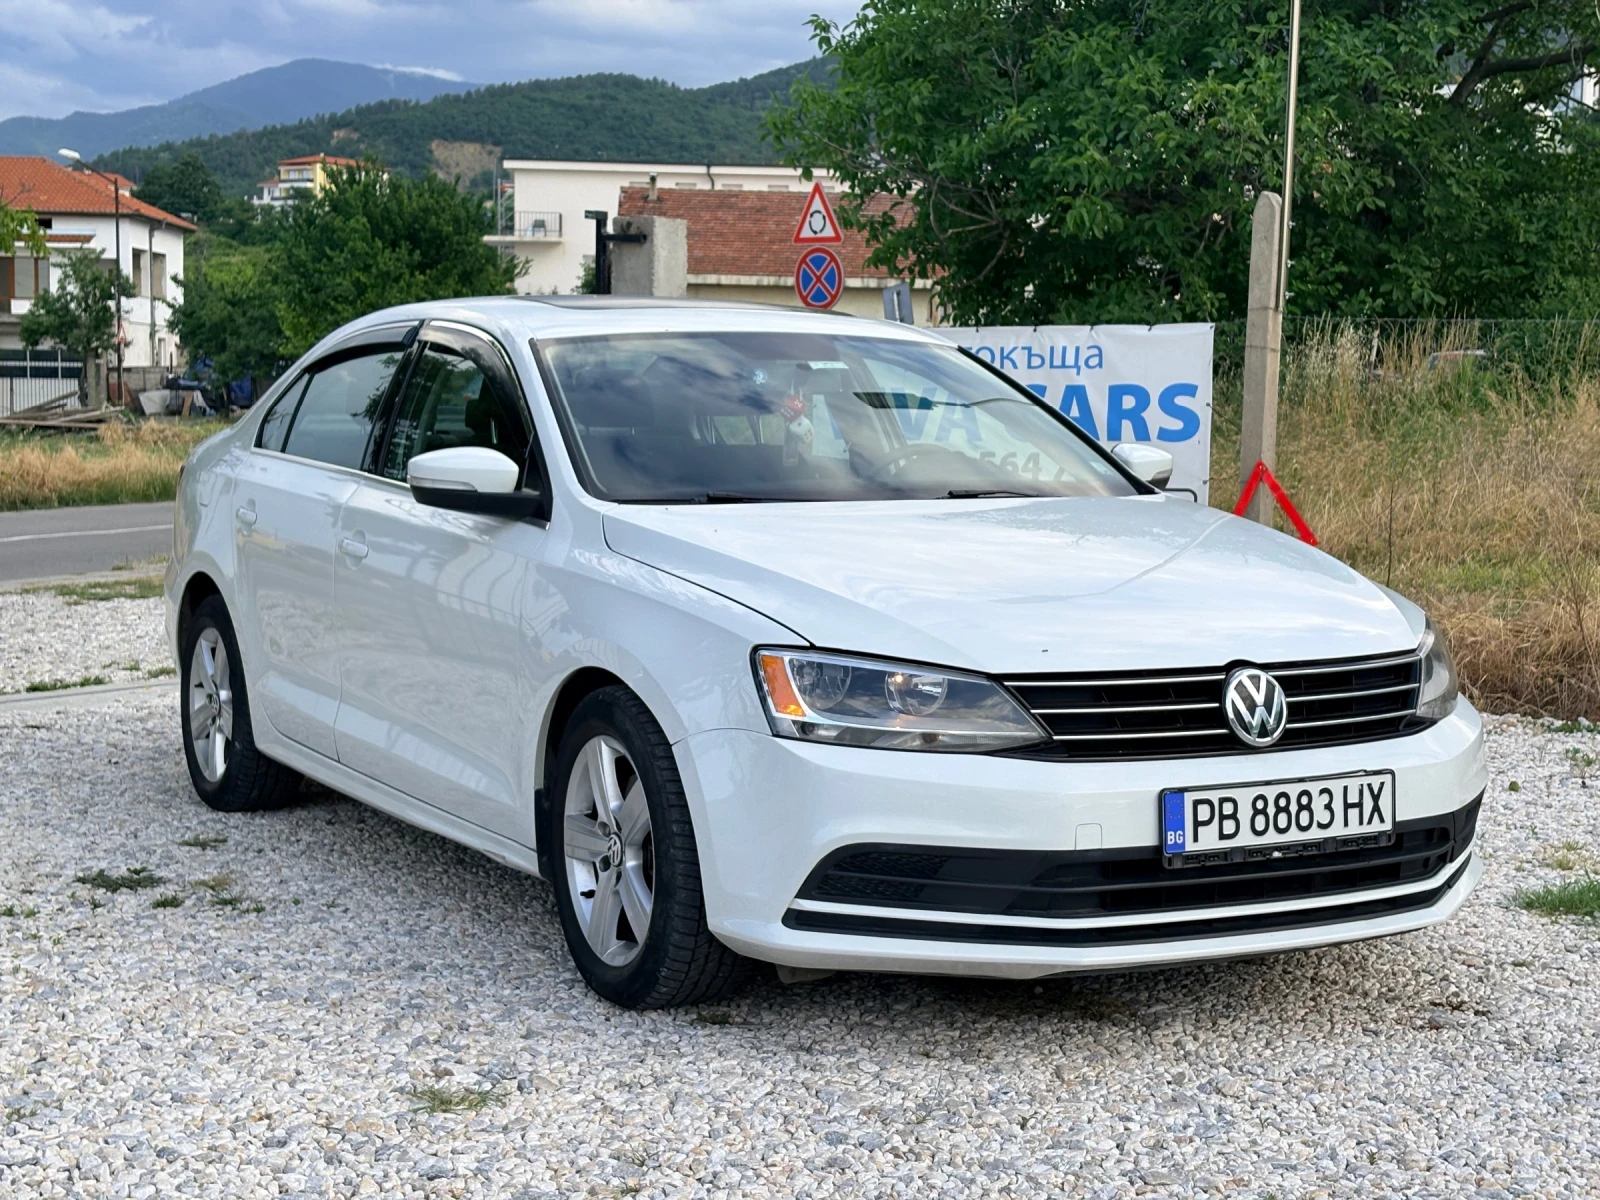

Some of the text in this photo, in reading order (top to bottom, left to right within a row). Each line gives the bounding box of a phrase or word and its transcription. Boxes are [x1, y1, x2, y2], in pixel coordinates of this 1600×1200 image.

[965, 344, 1104, 376] окъща
[1167, 781, 1386, 844] BG PB 8883 HX
